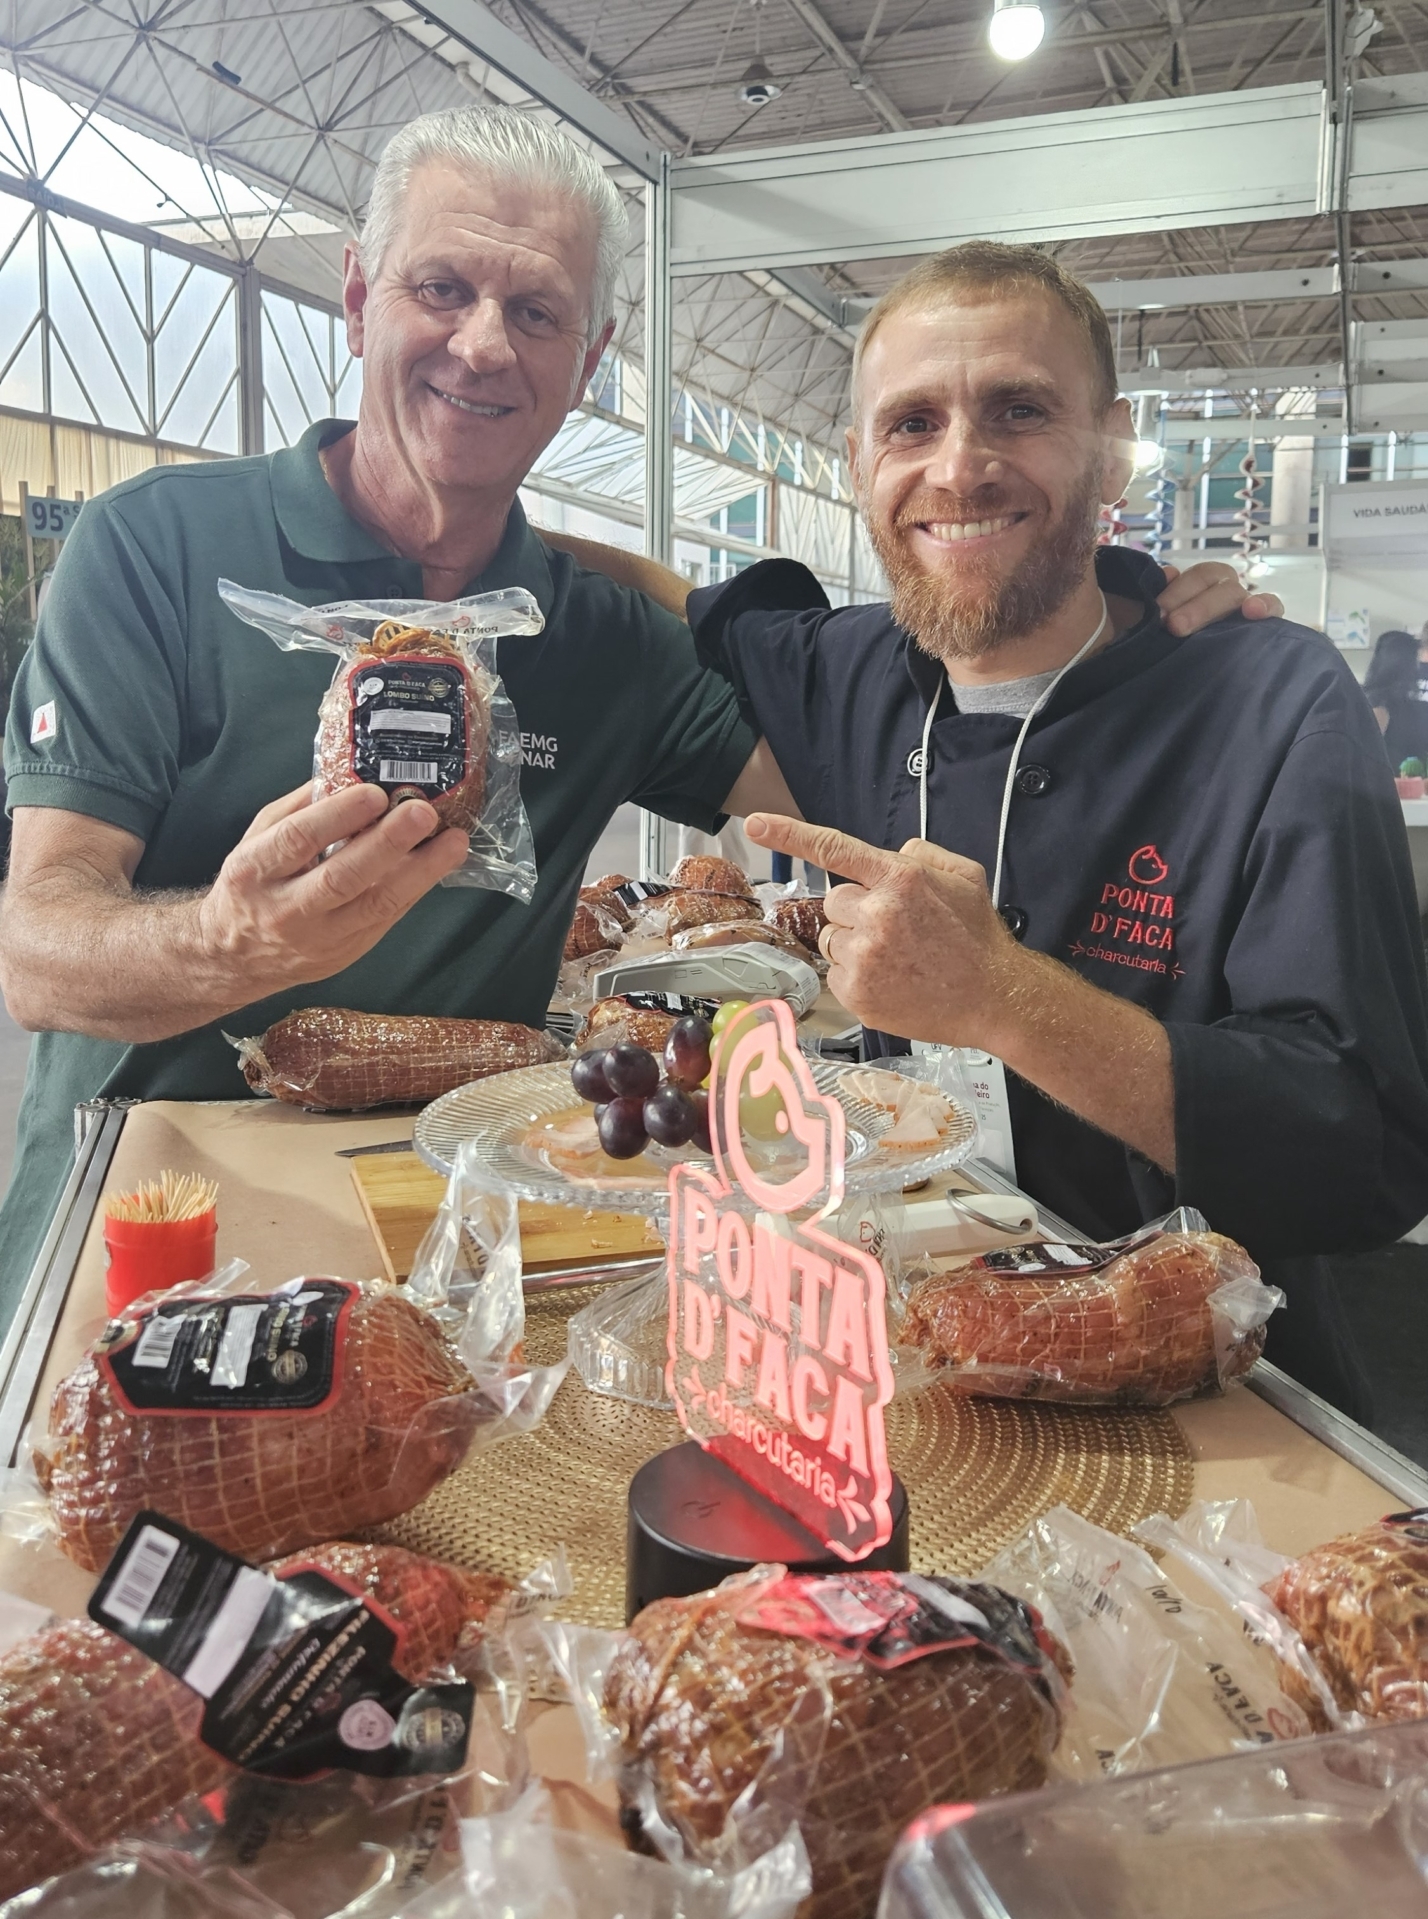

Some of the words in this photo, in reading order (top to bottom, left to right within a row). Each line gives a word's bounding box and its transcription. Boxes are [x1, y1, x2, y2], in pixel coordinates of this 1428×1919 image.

[1353, 506, 1382, 518] VIDA
[1384, 502, 1428, 517] SAUDÁ
[383, 690, 411, 700] LOMBO
[518, 750, 556, 770] NAR
[1100, 883, 1175, 919] PONTA
[1085, 943, 1167, 975] charcutaria
[980, 1081, 989, 1090] do
[683, 1184, 874, 1383] PONTA
[706, 1381, 838, 1508] charcutaria
[289, 1608, 370, 1702] FILEZINHO
[260, 1637, 321, 1709] Defumado
